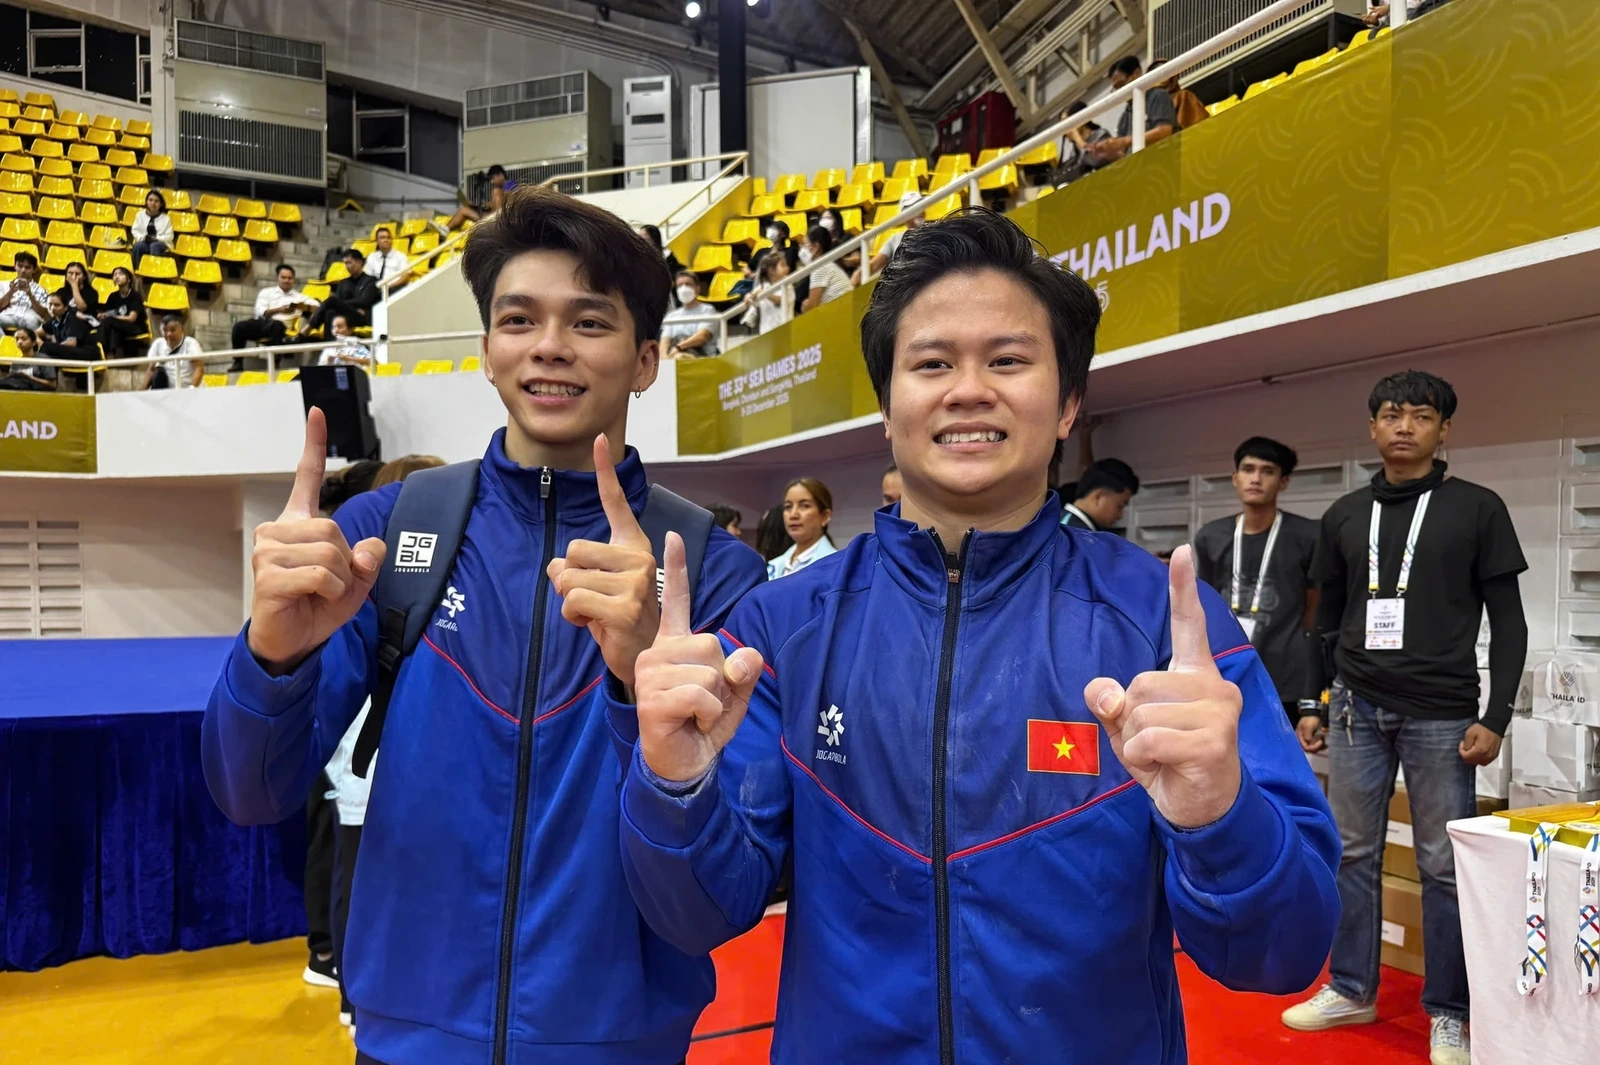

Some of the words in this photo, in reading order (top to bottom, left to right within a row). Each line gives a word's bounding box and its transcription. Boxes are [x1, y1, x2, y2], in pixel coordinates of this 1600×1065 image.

[718, 381, 733, 400] THE
[748, 368, 764, 389] SEA
[765, 355, 796, 382] GAMES
[797, 343, 822, 370] 2025
[0, 419, 58, 440] AND
[1551, 693, 1586, 703] HAILAD
